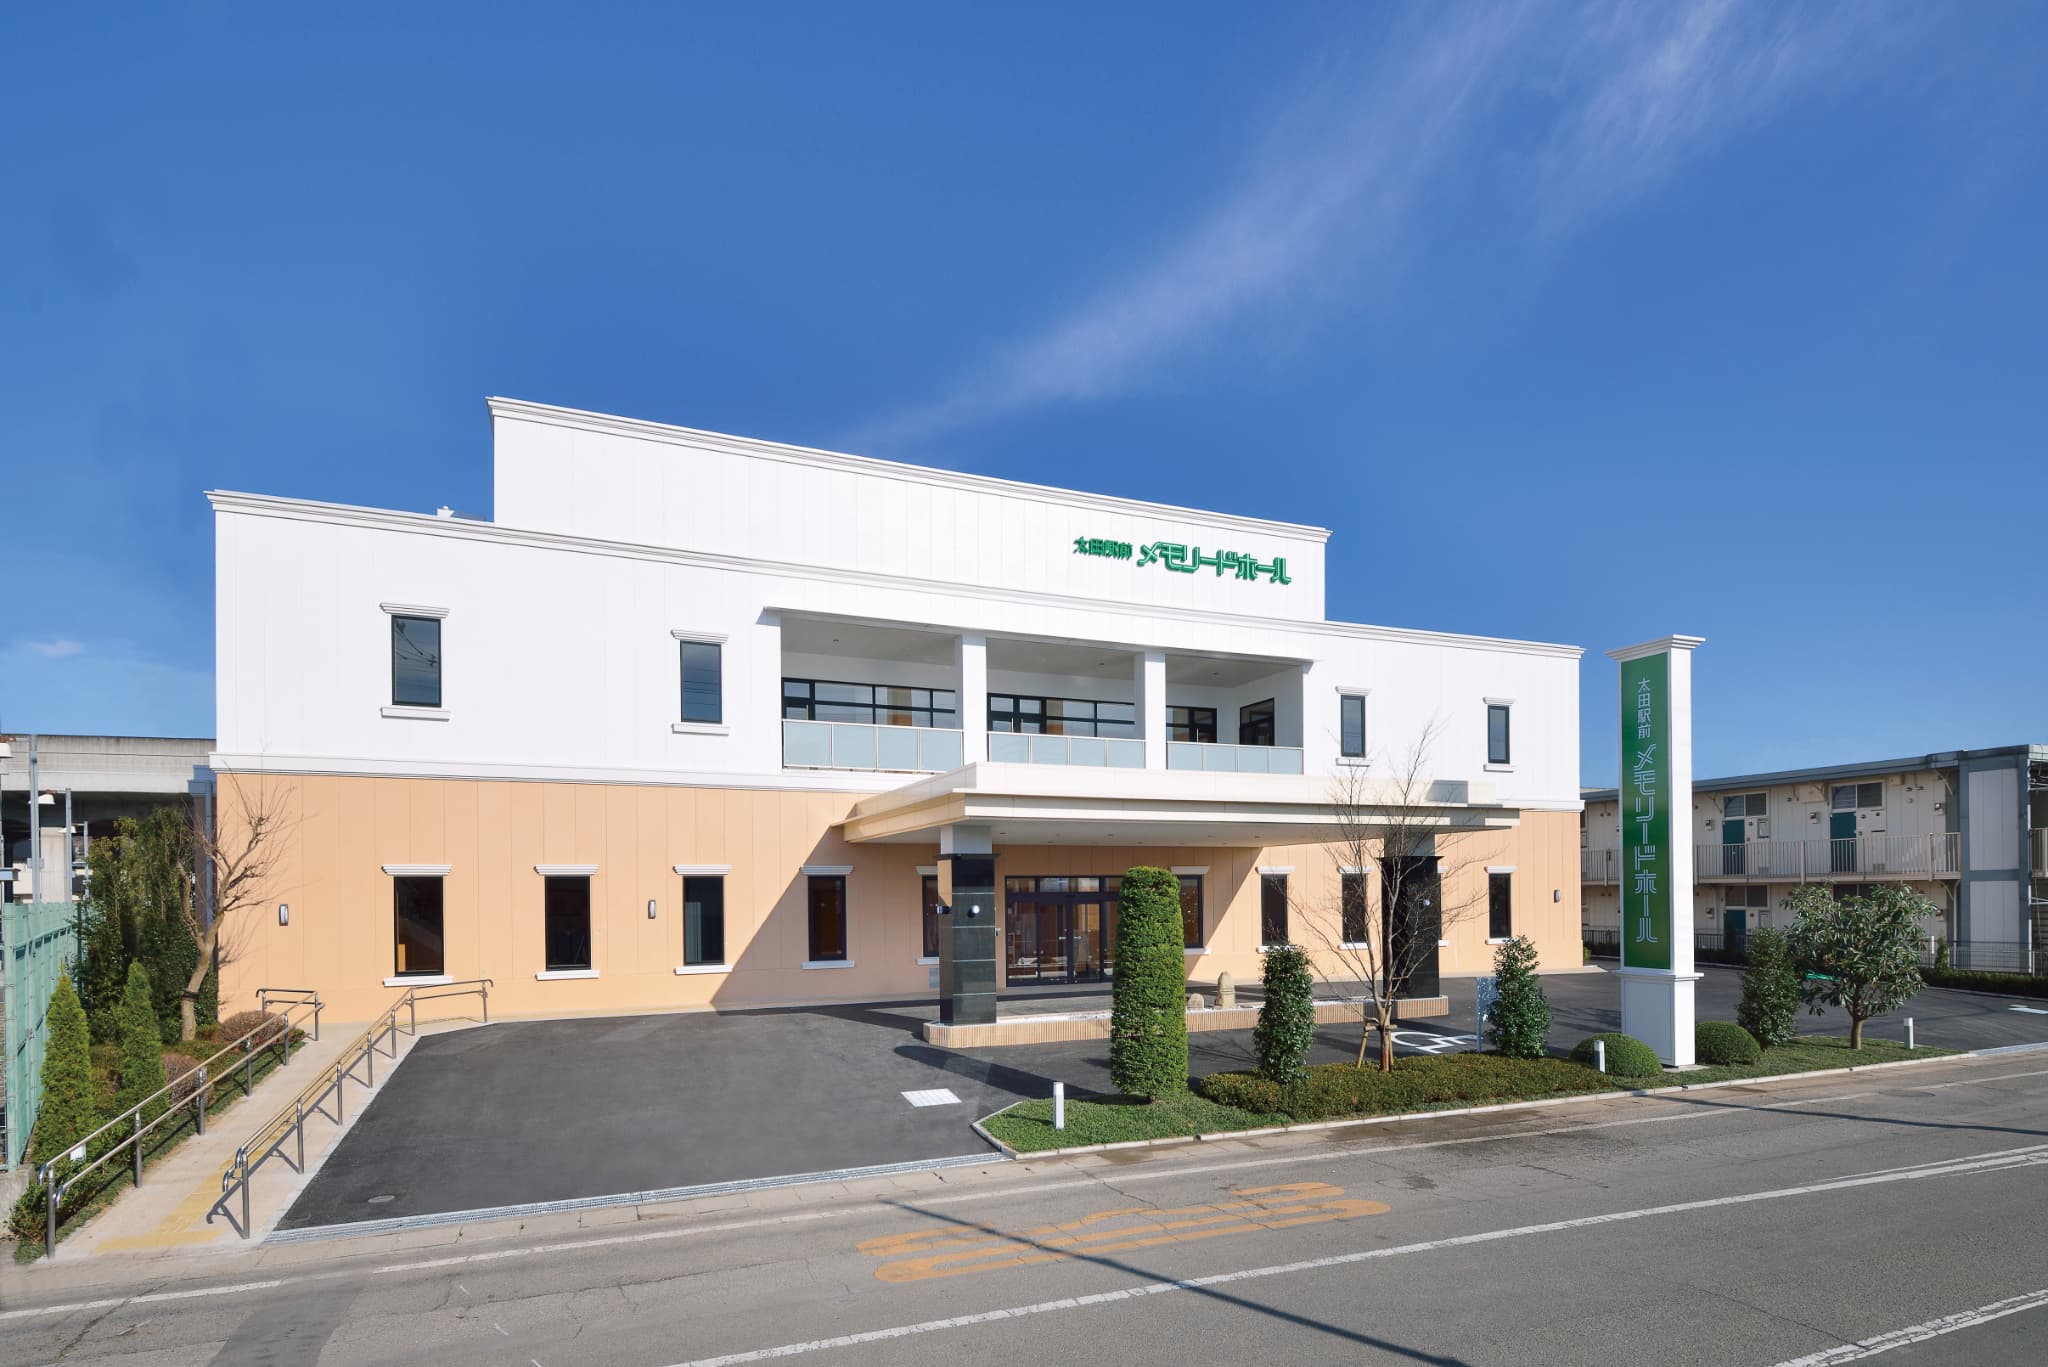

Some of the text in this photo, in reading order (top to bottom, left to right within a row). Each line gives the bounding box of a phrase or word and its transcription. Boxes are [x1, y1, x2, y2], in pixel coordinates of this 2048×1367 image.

[1073, 536, 1292, 585] 太田駅前 メモリードホール
[1633, 676, 1658, 944] 太田駅前 メモリードホール
[855, 1181, 1391, 1283] 30
